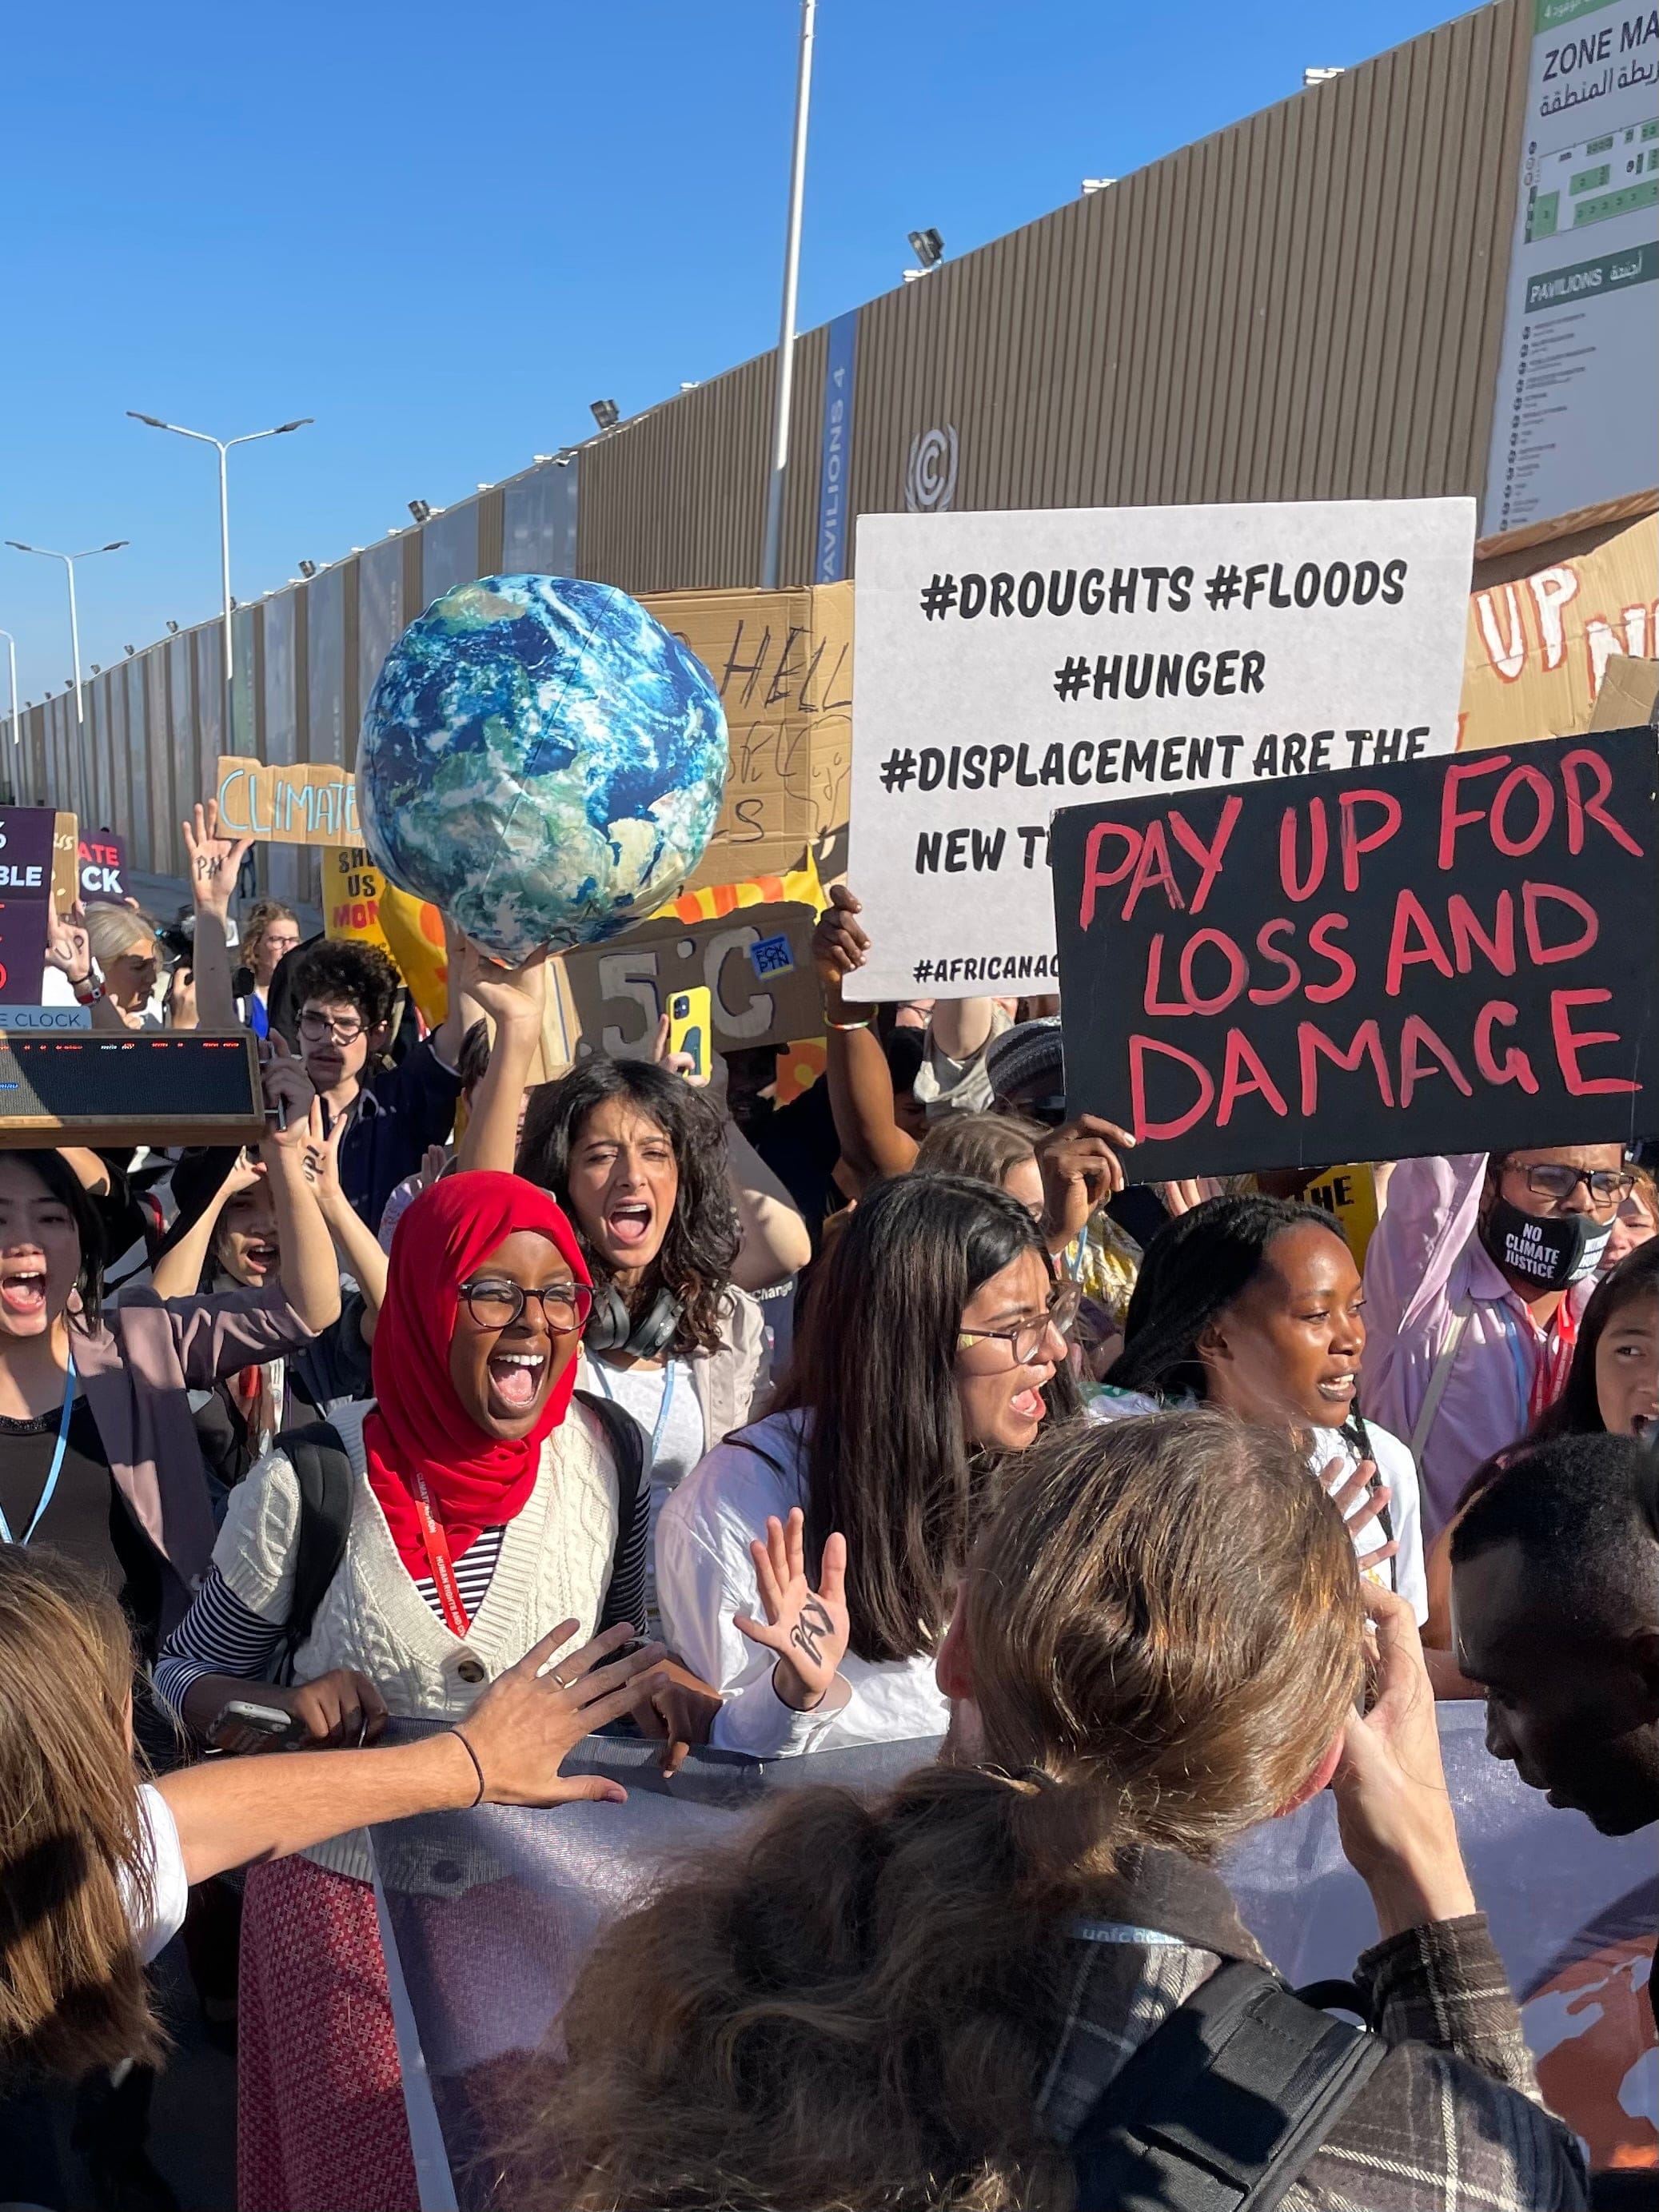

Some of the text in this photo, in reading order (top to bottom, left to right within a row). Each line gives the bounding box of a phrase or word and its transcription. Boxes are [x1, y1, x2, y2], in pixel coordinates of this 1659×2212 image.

[1542, 27, 1613, 82] ZONE
[1540, 67, 1613, 118] المنطقة
[1529, 268, 1602, 304] PAVILIONS
[919, 560, 1408, 621] #DROUGHTS #FLOODS
[1471, 564, 1580, 684] UP
[1053, 650, 1266, 702] #HUNGER
[879, 735, 1243, 793] #DISPLACEMENT
[1252, 730, 1335, 779] ARE
[1345, 727, 1430, 769] THE
[220, 769, 361, 835] CLIMATE
[915, 826, 1052, 875] NEW T
[1079, 748, 1644, 931] PAY UP FOR
[82, 866, 123, 894] CK
[349, 875, 376, 897] US
[1145, 881, 1598, 1015] LOSS AND
[14, 1013, 81, 1026] CLOCK
[1128, 988, 1643, 1144] DAMAGE
[1295, 1175, 1354, 1214] HE
[1505, 1233, 1560, 1265] CLIMATE
[1522, 1222, 1542, 1242] NO
[1505, 1249, 1555, 1279] JUSTICE
[444, 1584, 457, 1611] RIGHTS
[452, 1611, 462, 1626] AND
